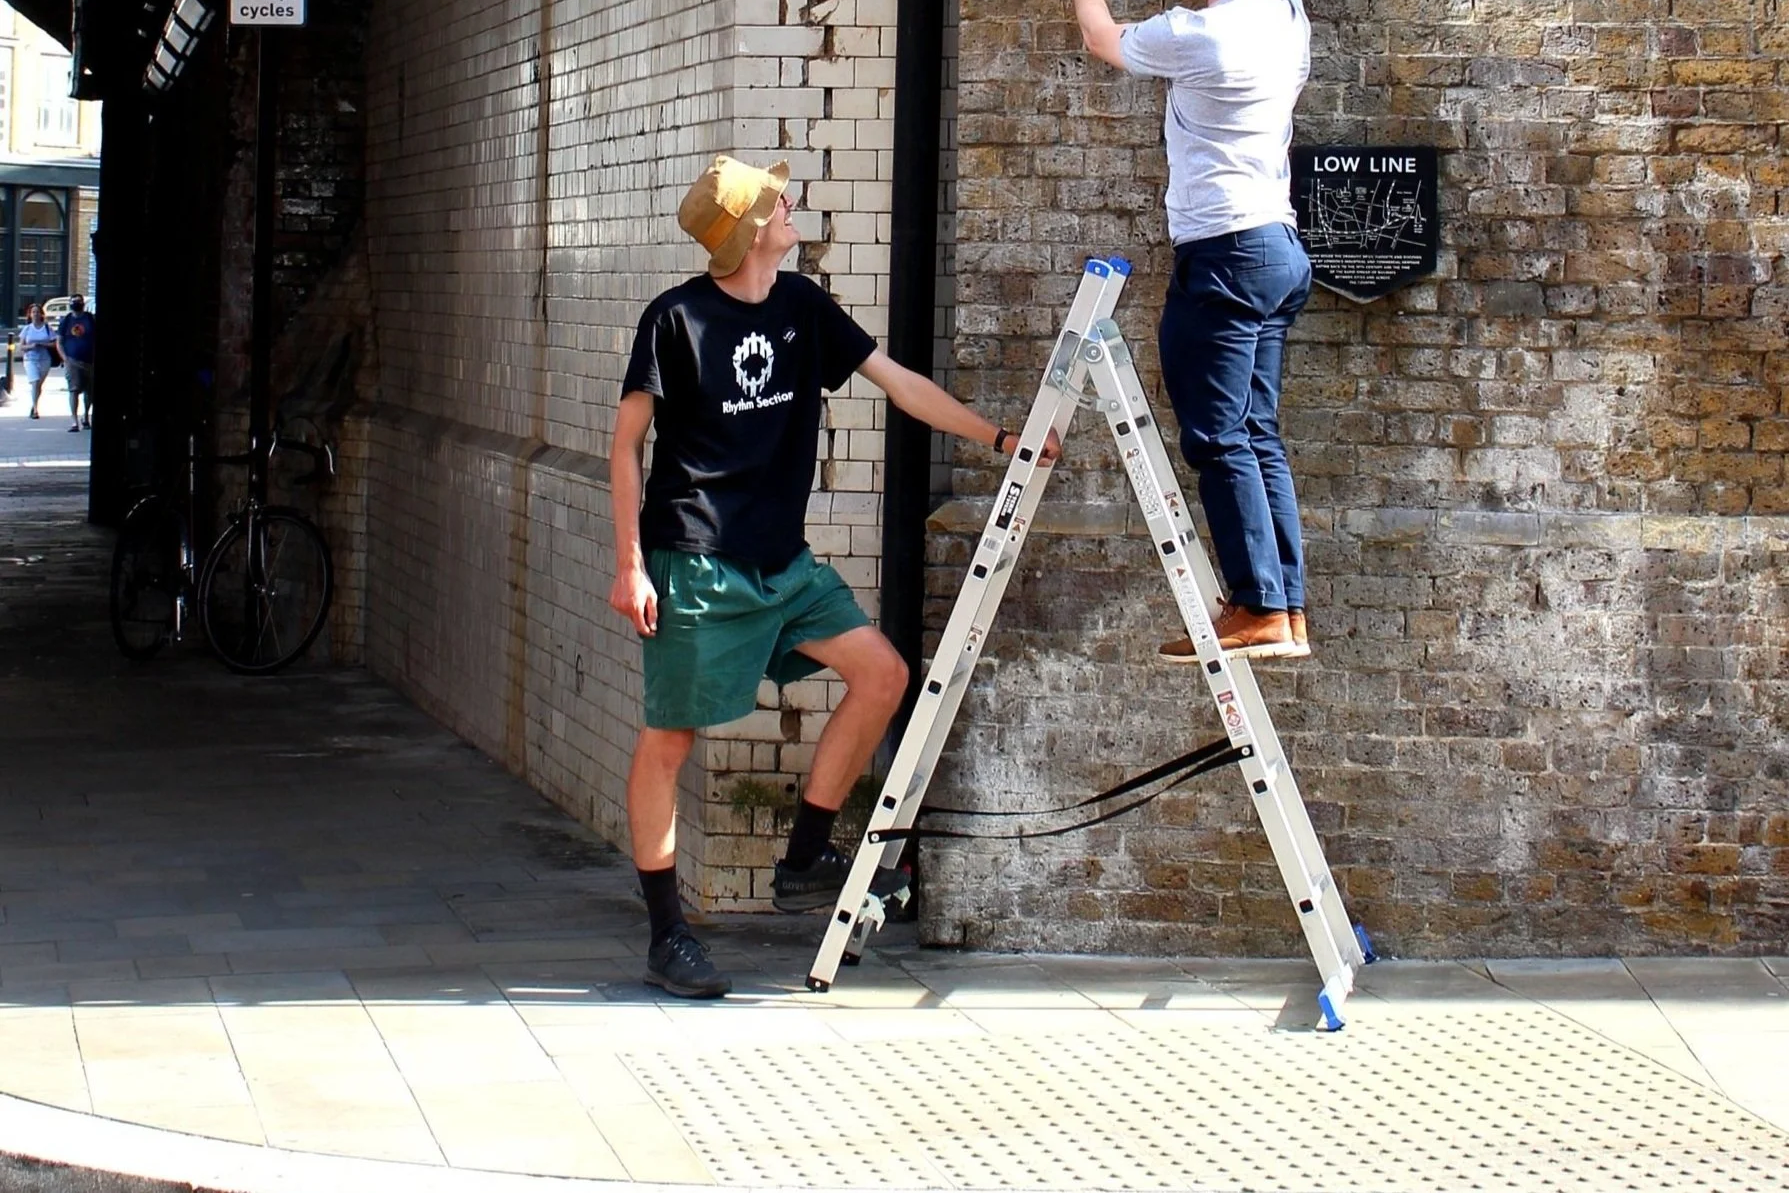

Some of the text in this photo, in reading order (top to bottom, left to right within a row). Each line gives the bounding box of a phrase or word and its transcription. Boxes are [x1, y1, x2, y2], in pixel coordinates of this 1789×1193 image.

[239, 2, 294, 19] cycles
[1313, 156, 1417, 174] LOW LINE
[722, 391, 794, 415] Rhythm Section
